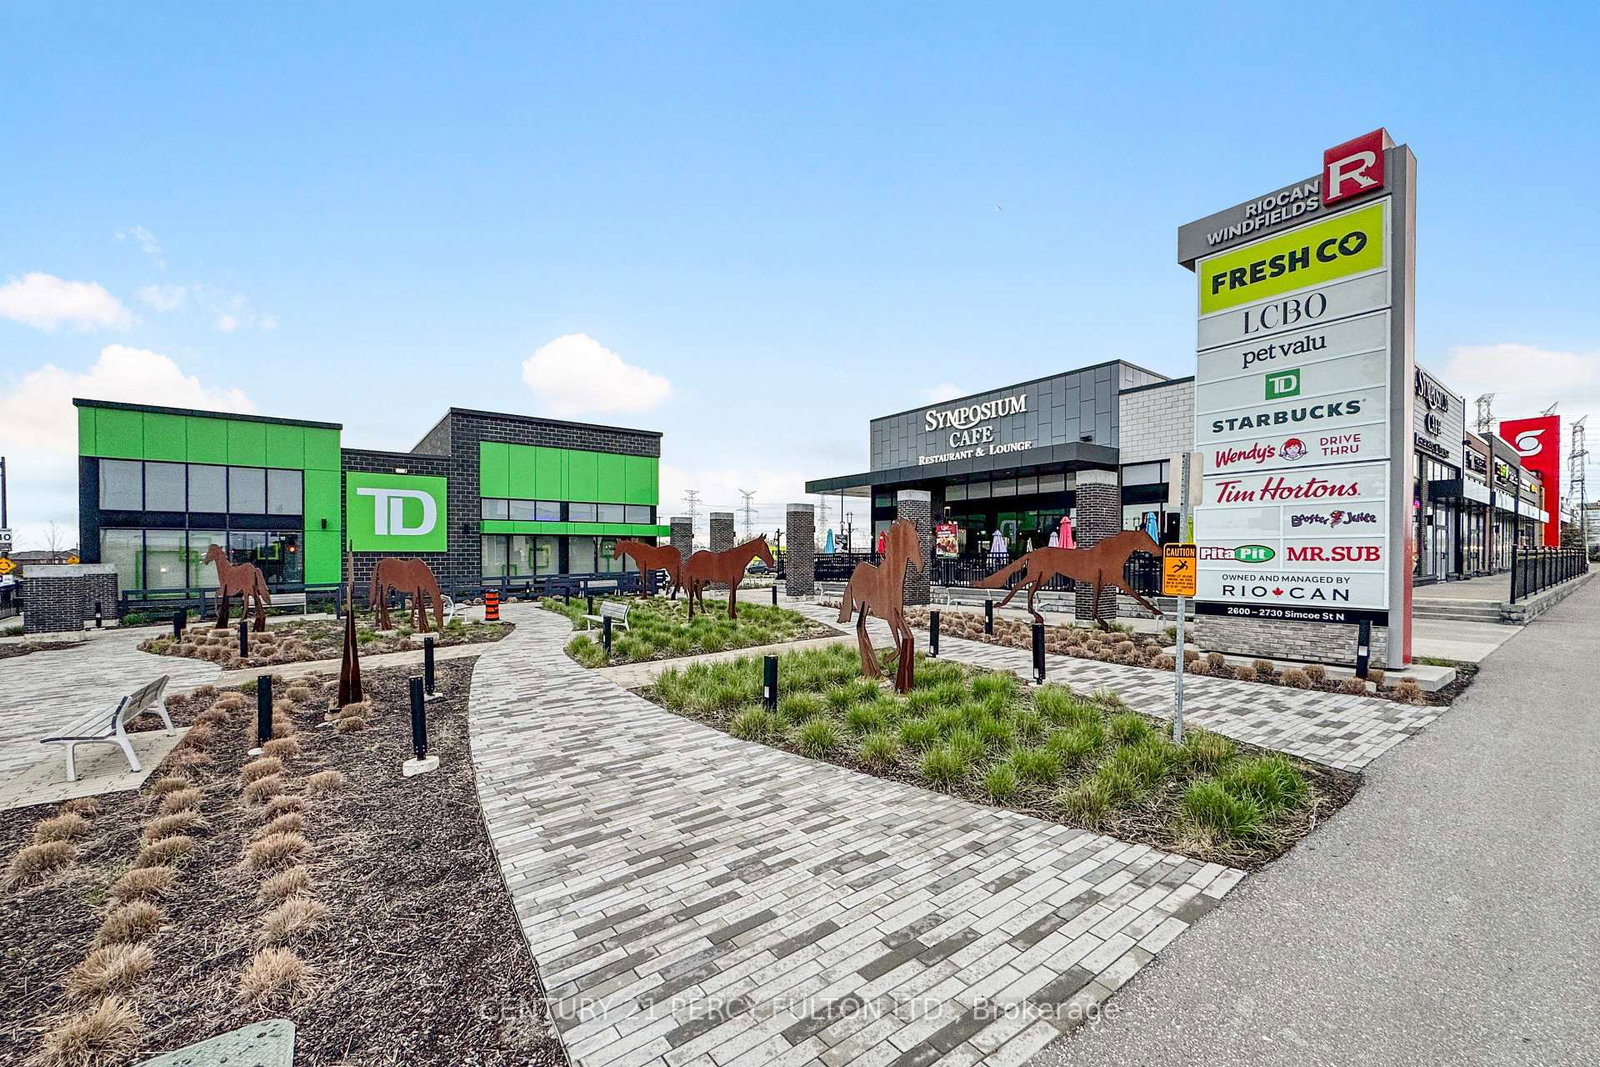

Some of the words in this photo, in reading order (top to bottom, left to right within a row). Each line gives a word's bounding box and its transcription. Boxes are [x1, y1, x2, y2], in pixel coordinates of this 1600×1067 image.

[1327, 150, 1378, 200] R
[1245, 179, 1320, 218] RIOCAN
[1206, 196, 1319, 246] WINDFIELDS
[1244, 292, 1327, 334] LCBO
[1242, 344, 1277, 369] pet
[1279, 335, 1327, 357] valu
[1268, 374, 1298, 396] TD
[925, 394, 1028, 432] SYMPOSIUM
[1212, 400, 1361, 433] STARBUCKS
[949, 425, 994, 448] CAFE
[1320, 433, 1361, 446] DRIVE
[918, 450, 974, 466] RESTAURANT
[975, 447, 986, 457] &
[989, 441, 1033, 455] LOUNGE
[1215, 443, 1277, 468] Wendy's
[1321, 444, 1360, 456] THRU
[1215, 480, 1255, 504] Tim
[1259, 476, 1359, 501] Hortons
[356, 487, 438, 536] TD
[1166, 547, 1195, 557] CAUTION
[1200, 547, 1236, 560] Pita
[1240, 547, 1266, 560] Pit
[1222, 573, 1257, 581] OWNED
[1281, 575, 1334, 584] MANAGED
[1336, 576, 1350, 584] BY
[1227, 607, 1251, 615] 2600
[1259, 609, 1283, 617] 2730
[1284, 610, 1320, 620] Simcoe
[1322, 612, 1334, 620] St
